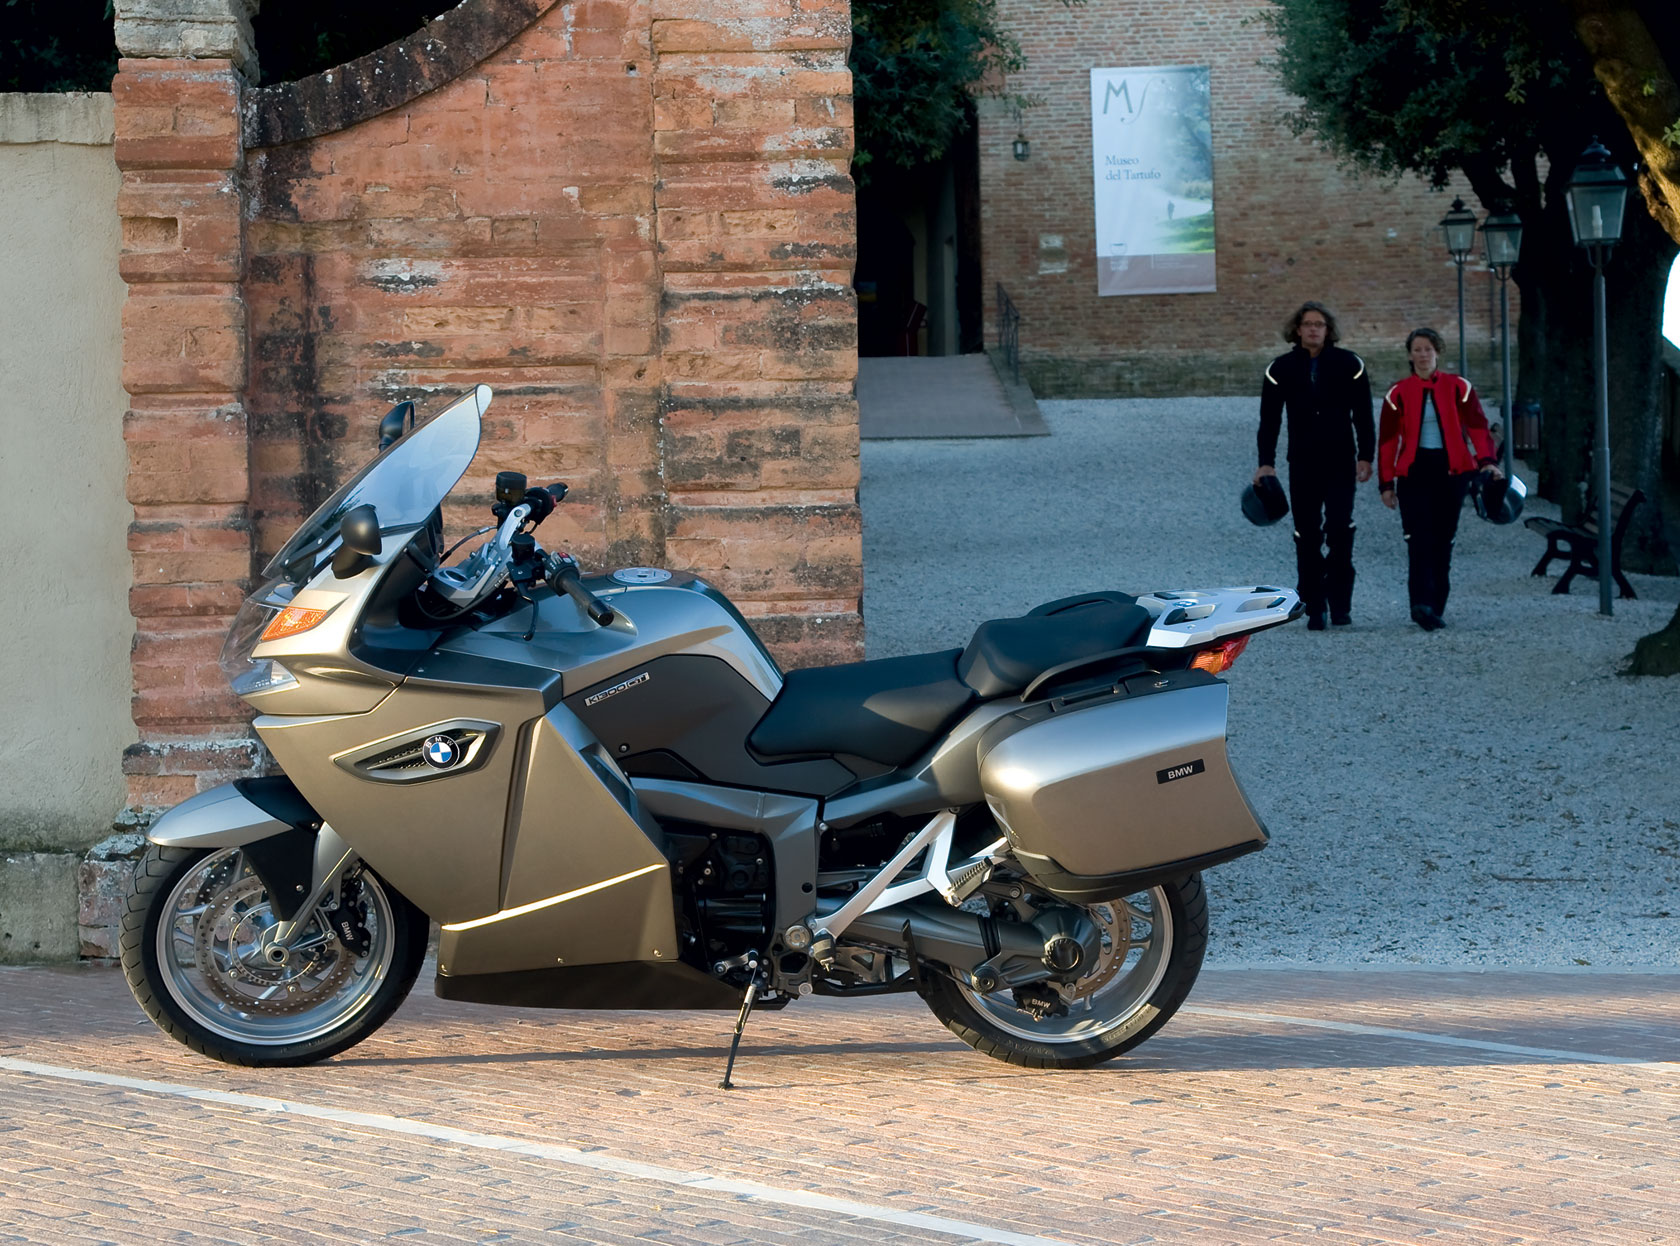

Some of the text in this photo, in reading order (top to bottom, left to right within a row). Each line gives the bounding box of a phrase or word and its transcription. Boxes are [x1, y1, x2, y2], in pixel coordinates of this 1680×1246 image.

[1104, 154, 1140, 166] Museo
[1105, 167, 1162, 181] del Tartufo
[1167, 765, 1193, 780] BMW
[341, 920, 355, 941] BMW
[1031, 998, 1051, 1009] BMW
